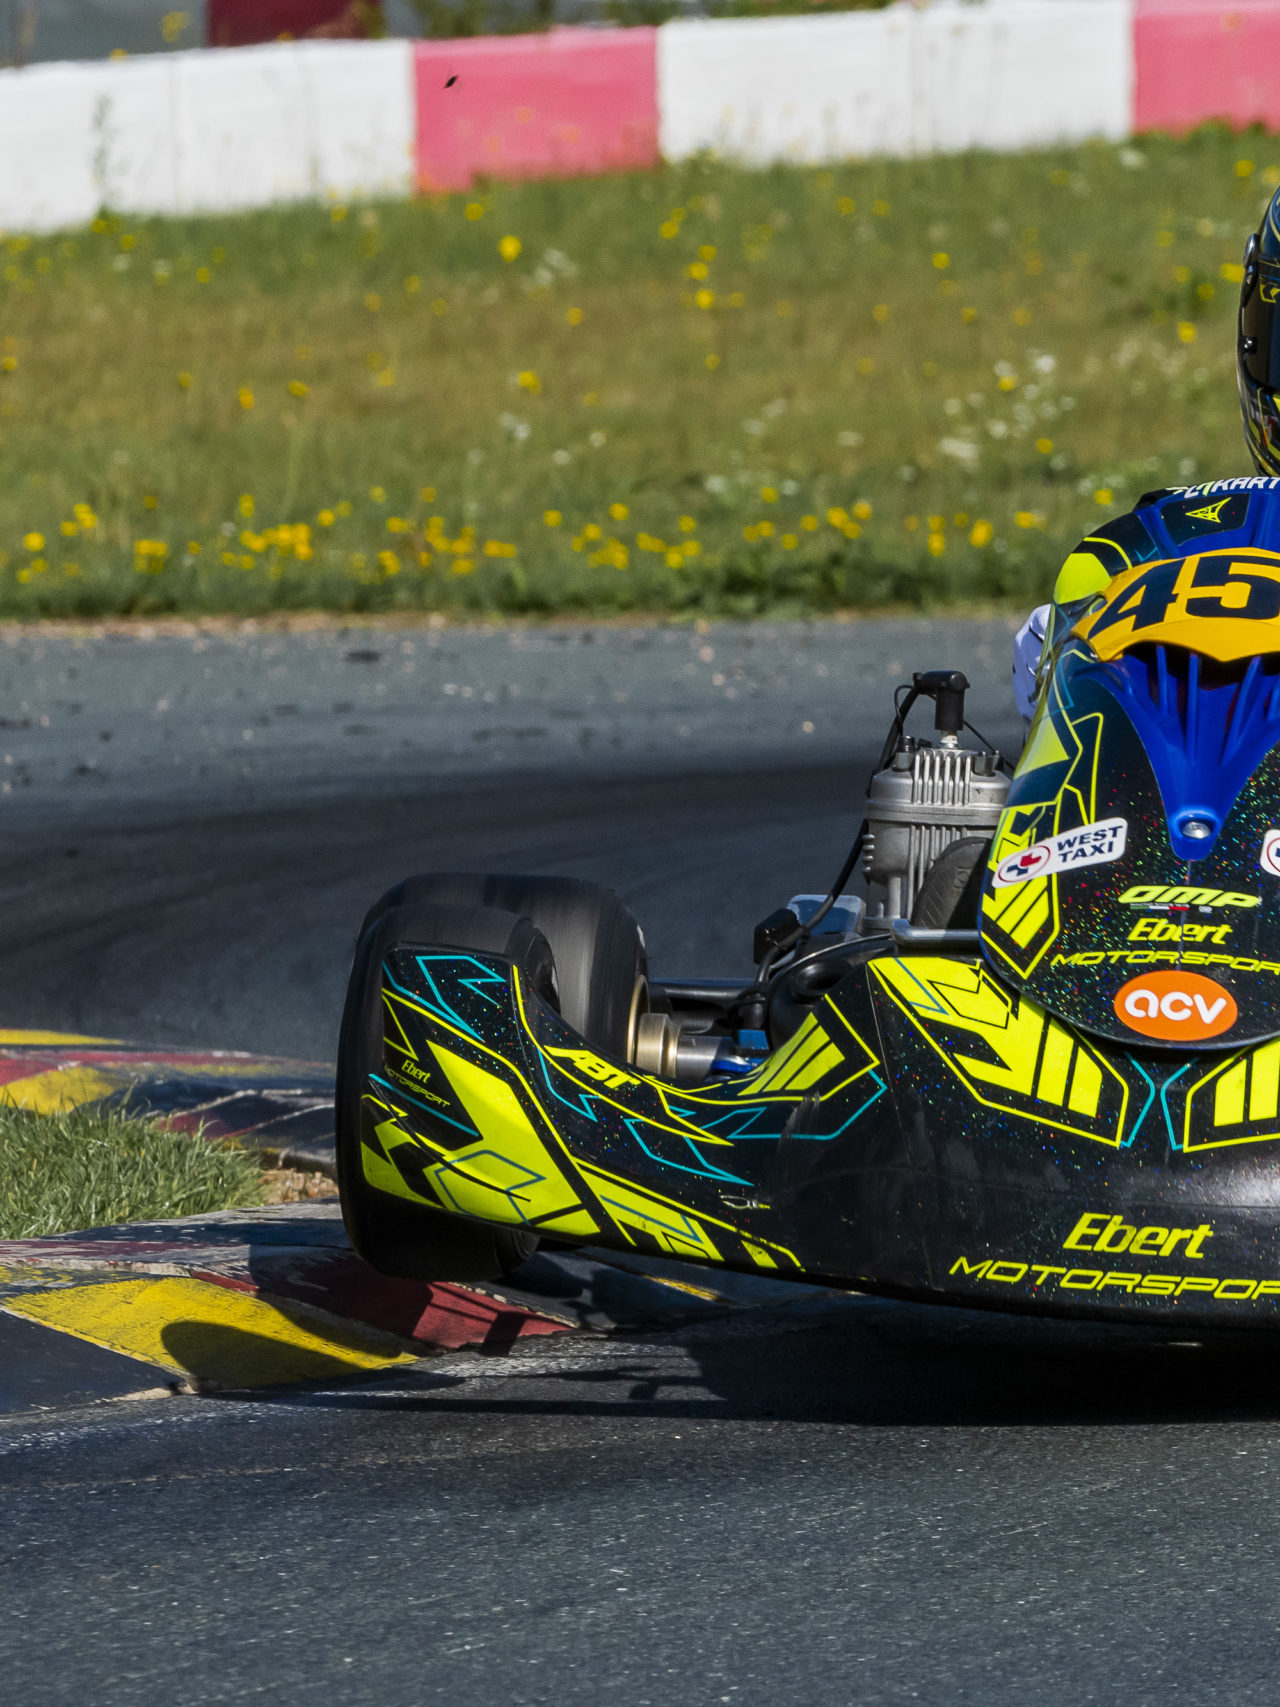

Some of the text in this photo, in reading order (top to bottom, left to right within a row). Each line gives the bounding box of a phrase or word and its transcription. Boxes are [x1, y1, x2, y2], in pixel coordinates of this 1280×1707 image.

[1056, 824, 1124, 852] WEST
[1058, 840, 1115, 864] TAXI
[1127, 917, 1234, 945] Ebert
[1124, 989, 1227, 1025] acv
[401, 1059, 431, 1084] Ebert
[1063, 1212, 1214, 1259] Ebert
